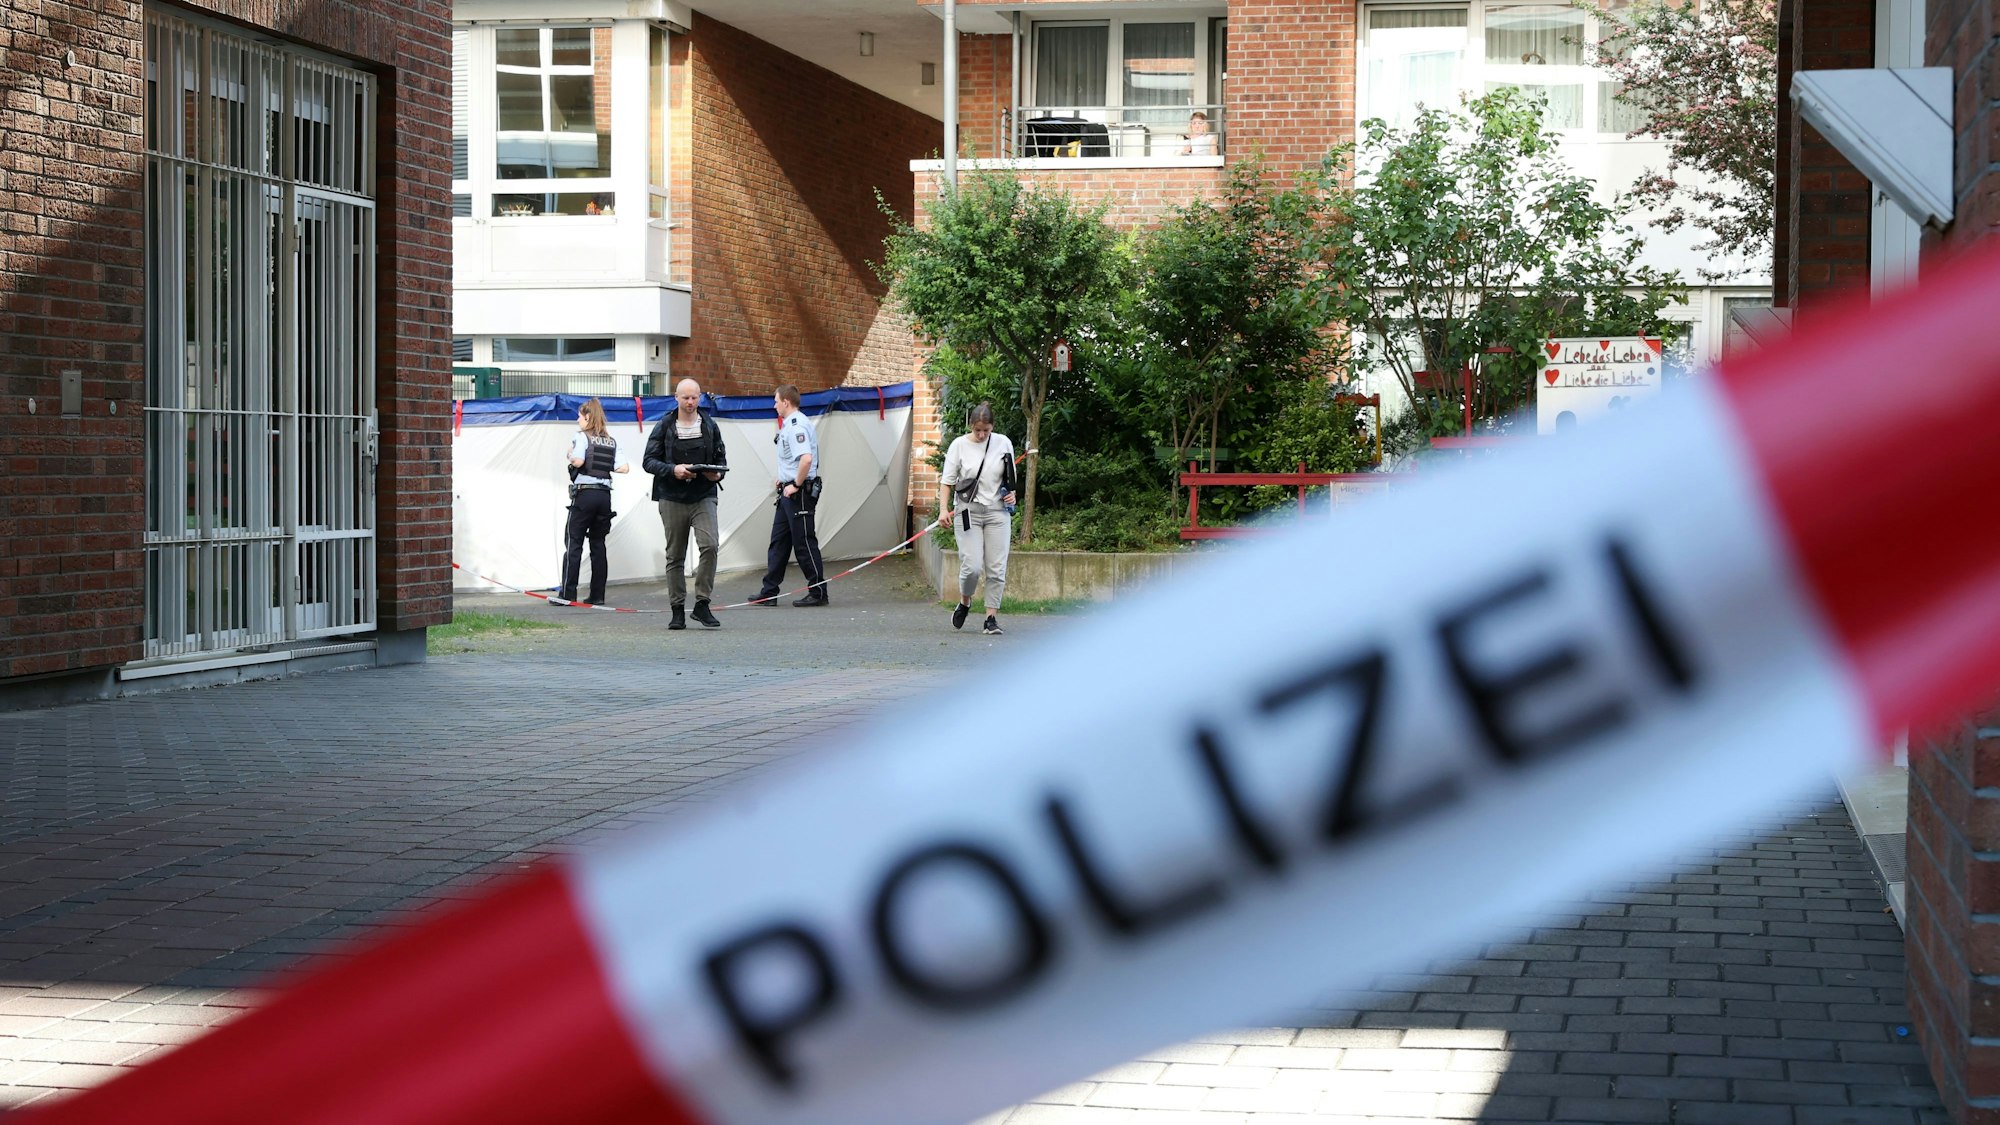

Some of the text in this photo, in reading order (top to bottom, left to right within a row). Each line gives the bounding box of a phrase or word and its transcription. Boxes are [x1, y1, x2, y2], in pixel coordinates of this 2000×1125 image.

[1564, 345, 1651, 364] Lebe das Leben
[1564, 370, 1643, 387] Liebe die Liebe
[591, 436, 616, 448] POLIZEI
[698, 534, 1699, 1091] POLIZEI
